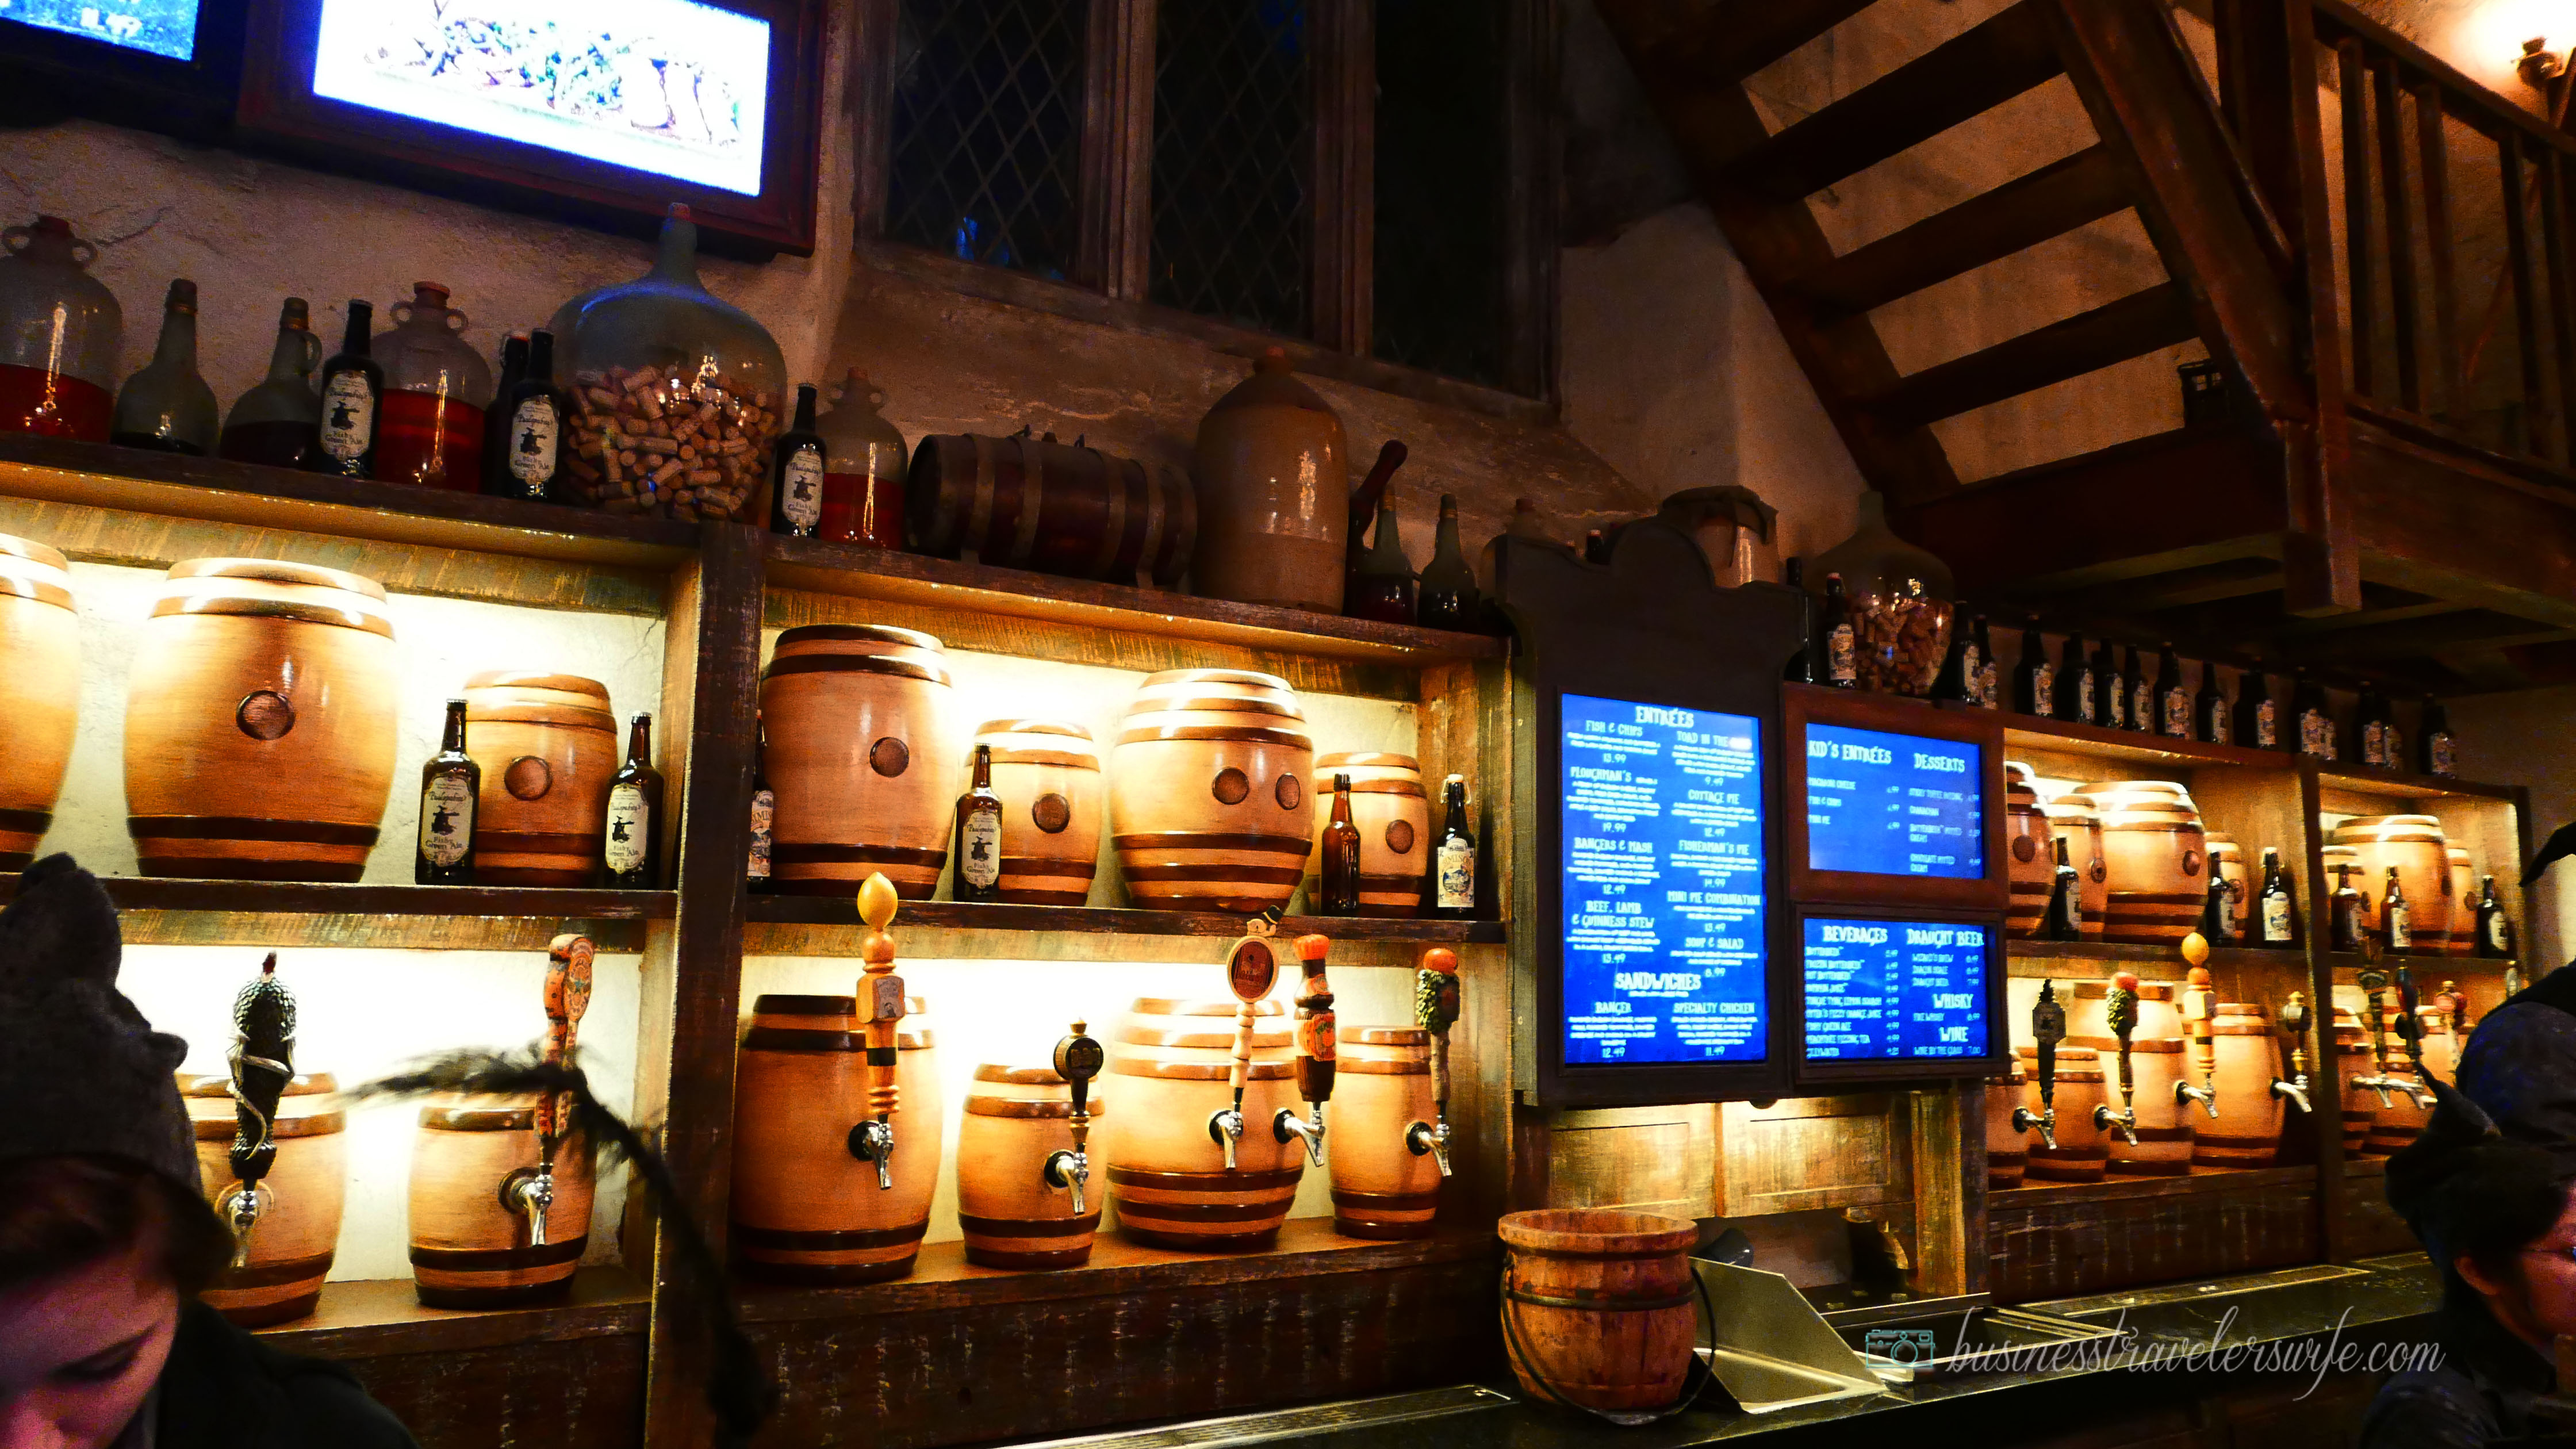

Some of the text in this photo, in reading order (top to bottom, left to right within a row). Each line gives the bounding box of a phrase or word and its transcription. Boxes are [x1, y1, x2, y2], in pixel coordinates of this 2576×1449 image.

[1586, 720, 1605, 733] FISH
[1617, 724, 1643, 737] CHIPS
[1677, 731, 1698, 743] TOAD
[1701, 733, 1711, 745] IN
[1914, 753, 1965, 773] DESSERTS
[1688, 789, 1739, 806] COTTAGE PIE
[1574, 837, 1616, 853] BANGERS
[1628, 841, 1653, 853] MASH
[1736, 844, 1750, 855] PIE
[1690, 892, 1703, 904] PIE
[1616, 902, 1642, 914] LAMB
[1582, 916, 1627, 929] GUINNESS
[1629, 917, 1655, 929] STEW
[1822, 926, 1888, 946] BEVERAGES
[1907, 929, 1984, 949] DRAUGHT BEER
[1717, 938, 1745, 950] SALAD
[1615, 972, 1701, 991] SANDWICHES
[1594, 1002, 1632, 1015] BANGER
[1673, 1002, 1755, 1014] SPECIALTY CHICKEN
[1933, 994, 1973, 1009] WHISKY
[1939, 1026, 1969, 1042] WINE
